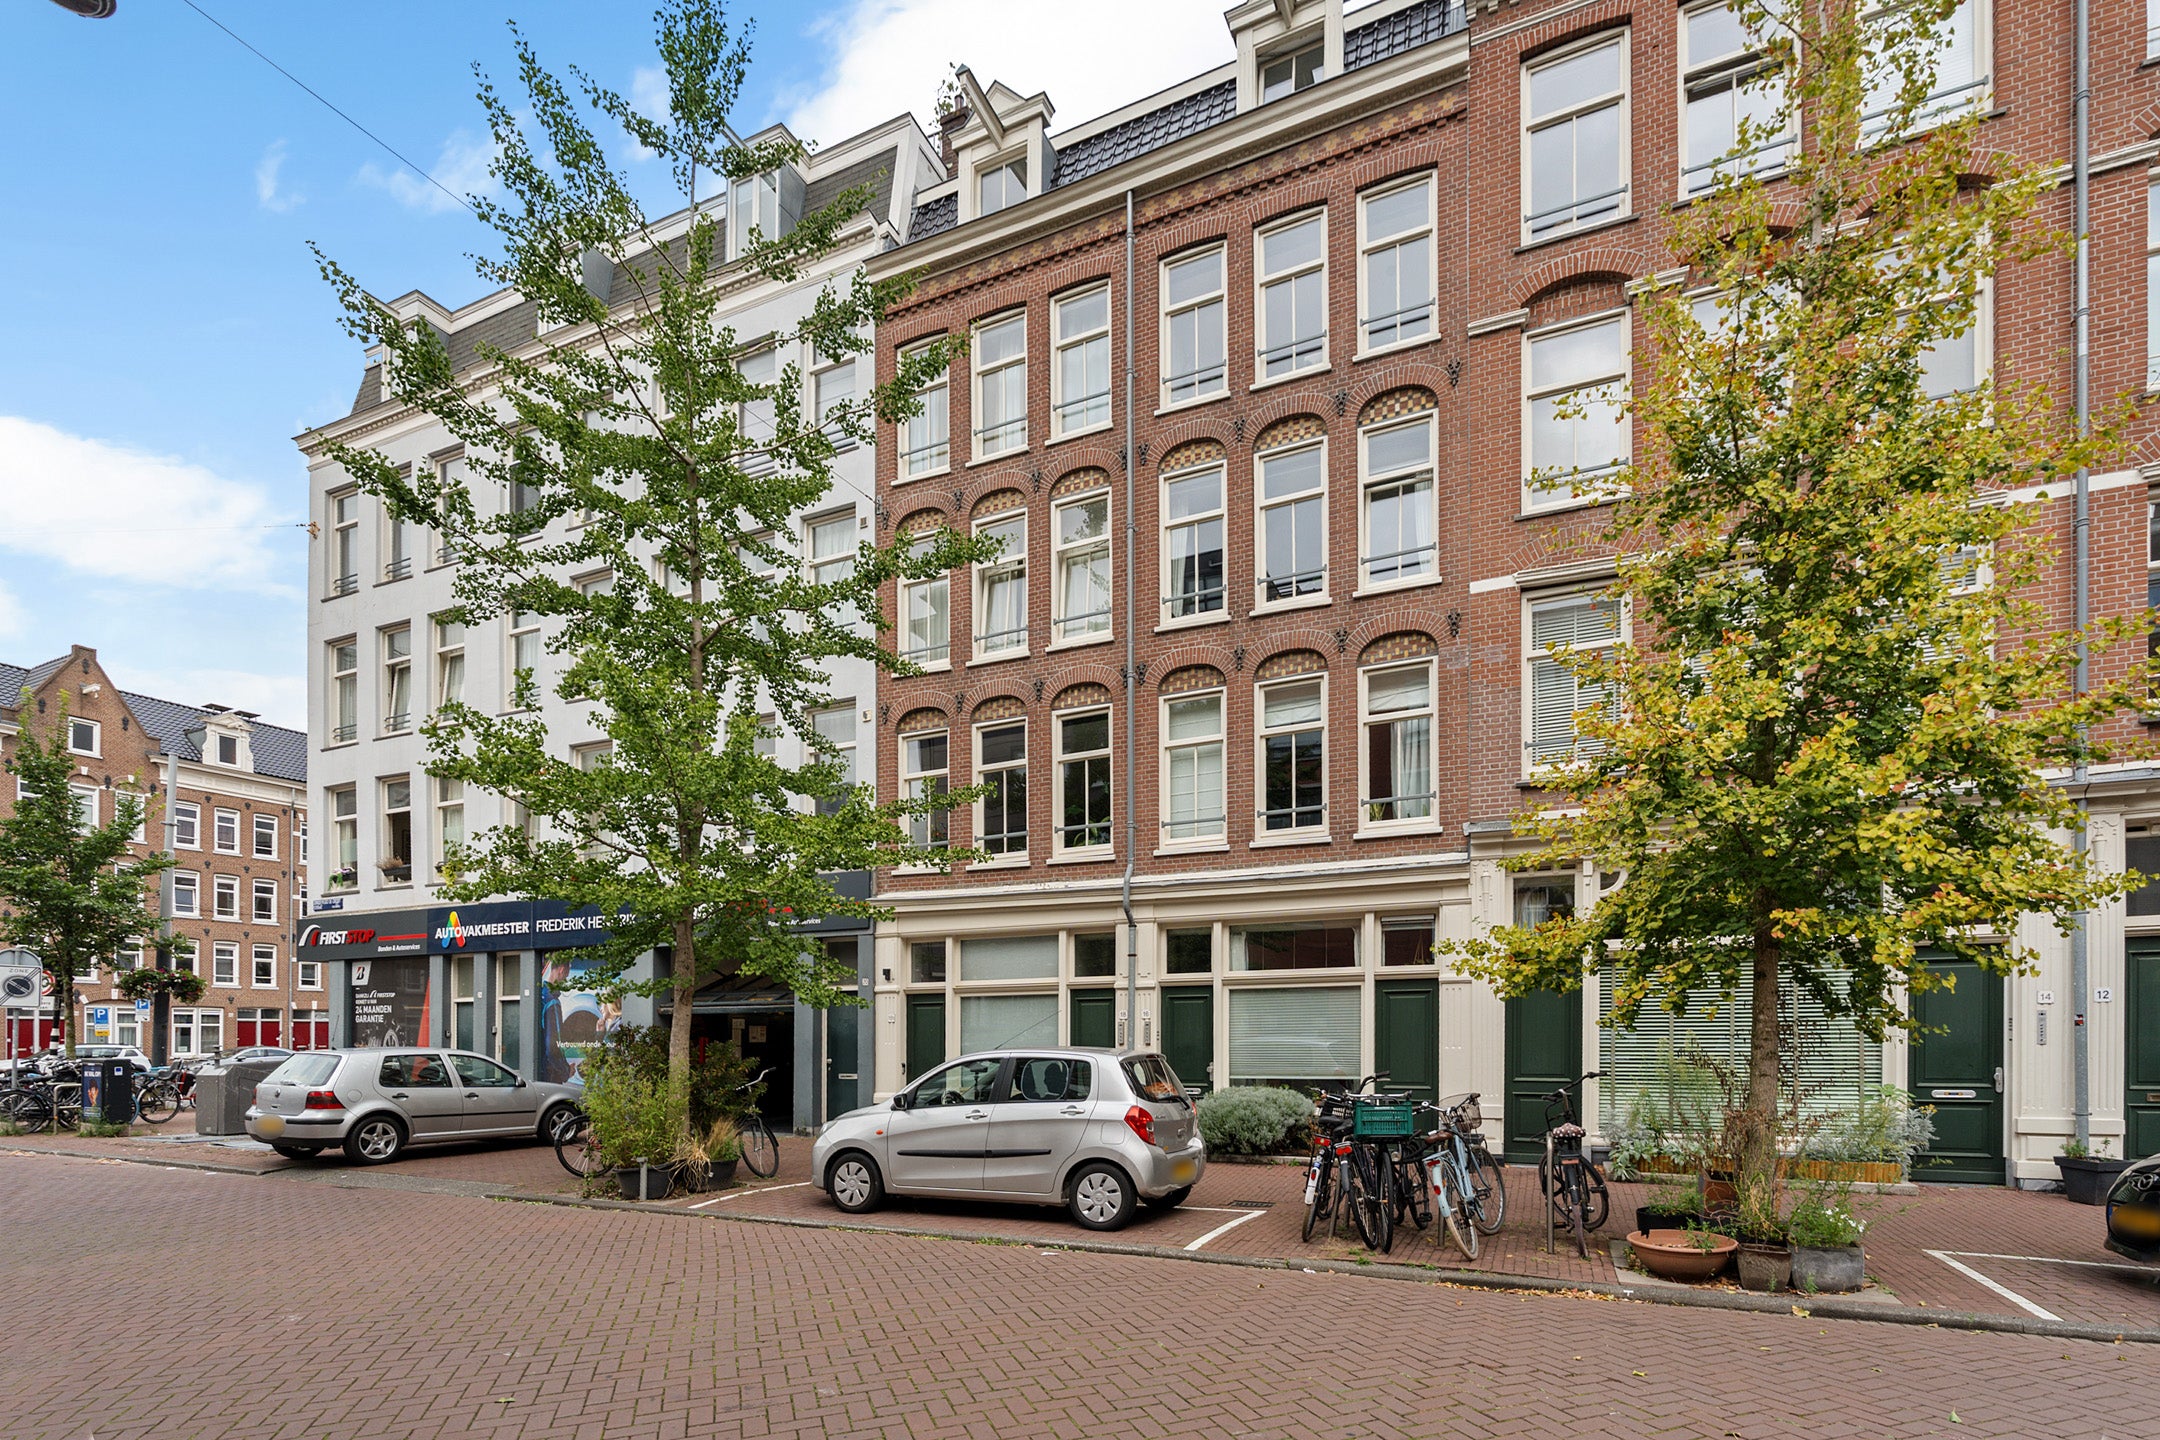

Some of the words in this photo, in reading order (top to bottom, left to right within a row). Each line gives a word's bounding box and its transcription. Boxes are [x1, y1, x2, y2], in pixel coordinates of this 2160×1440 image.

[435, 921, 529, 939] AUTOVAKMEESTER
[536, 917, 585, 933] FREDERIK
[320, 930, 374, 945] FIRSTSTOP
[2040, 993, 2051, 1001] 14
[2097, 990, 2109, 1000] 12
[97, 1009, 106, 1019] P
[355, 1006, 362, 1014] 24
[363, 1005, 391, 1013] MAANDEN
[355, 1015, 384, 1023] GARANTIE
[556, 1040, 586, 1048] Vertrouwd
